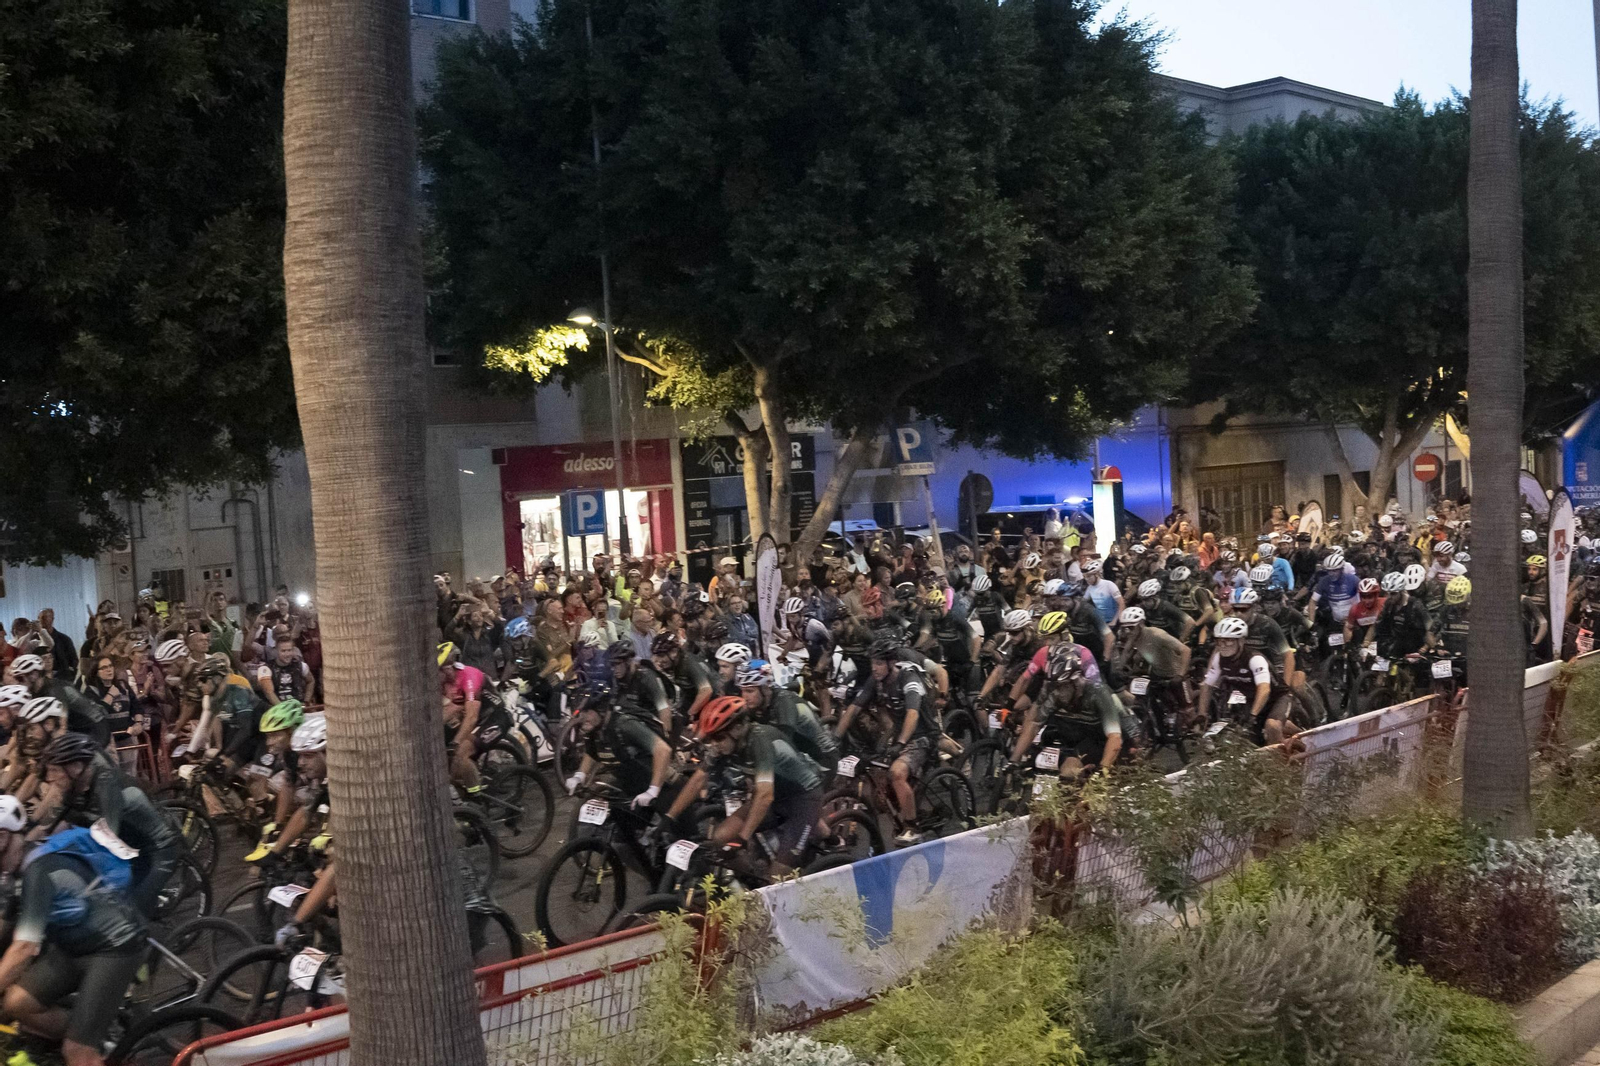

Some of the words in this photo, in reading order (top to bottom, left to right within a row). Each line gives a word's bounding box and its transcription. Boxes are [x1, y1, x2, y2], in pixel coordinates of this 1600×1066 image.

[896, 427, 921, 461] P
[563, 452, 614, 472] adesso
[576, 494, 598, 531] P
